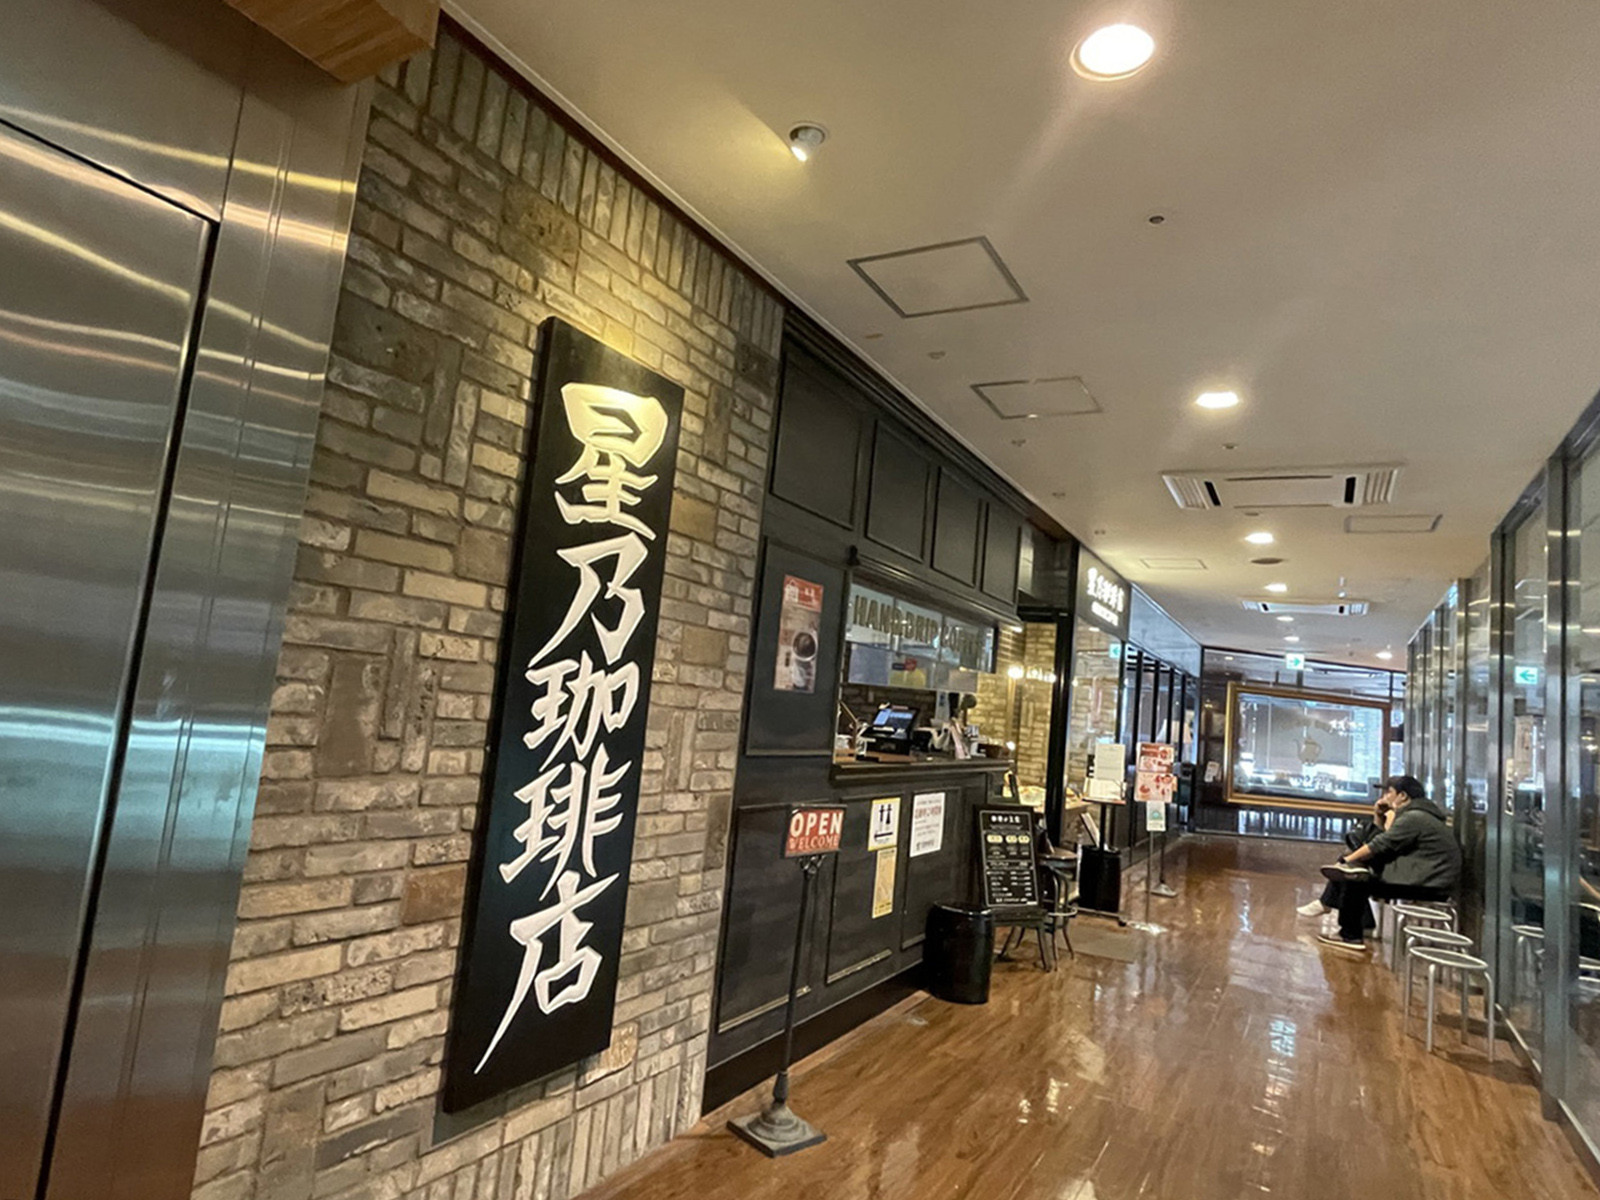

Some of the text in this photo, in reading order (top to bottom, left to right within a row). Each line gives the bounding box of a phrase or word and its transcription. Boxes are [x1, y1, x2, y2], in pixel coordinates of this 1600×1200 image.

[474, 382, 670, 1075] 星乃珈琲店
[790, 812, 843, 838] OPEN
[789, 835, 839, 850] WELCOME
